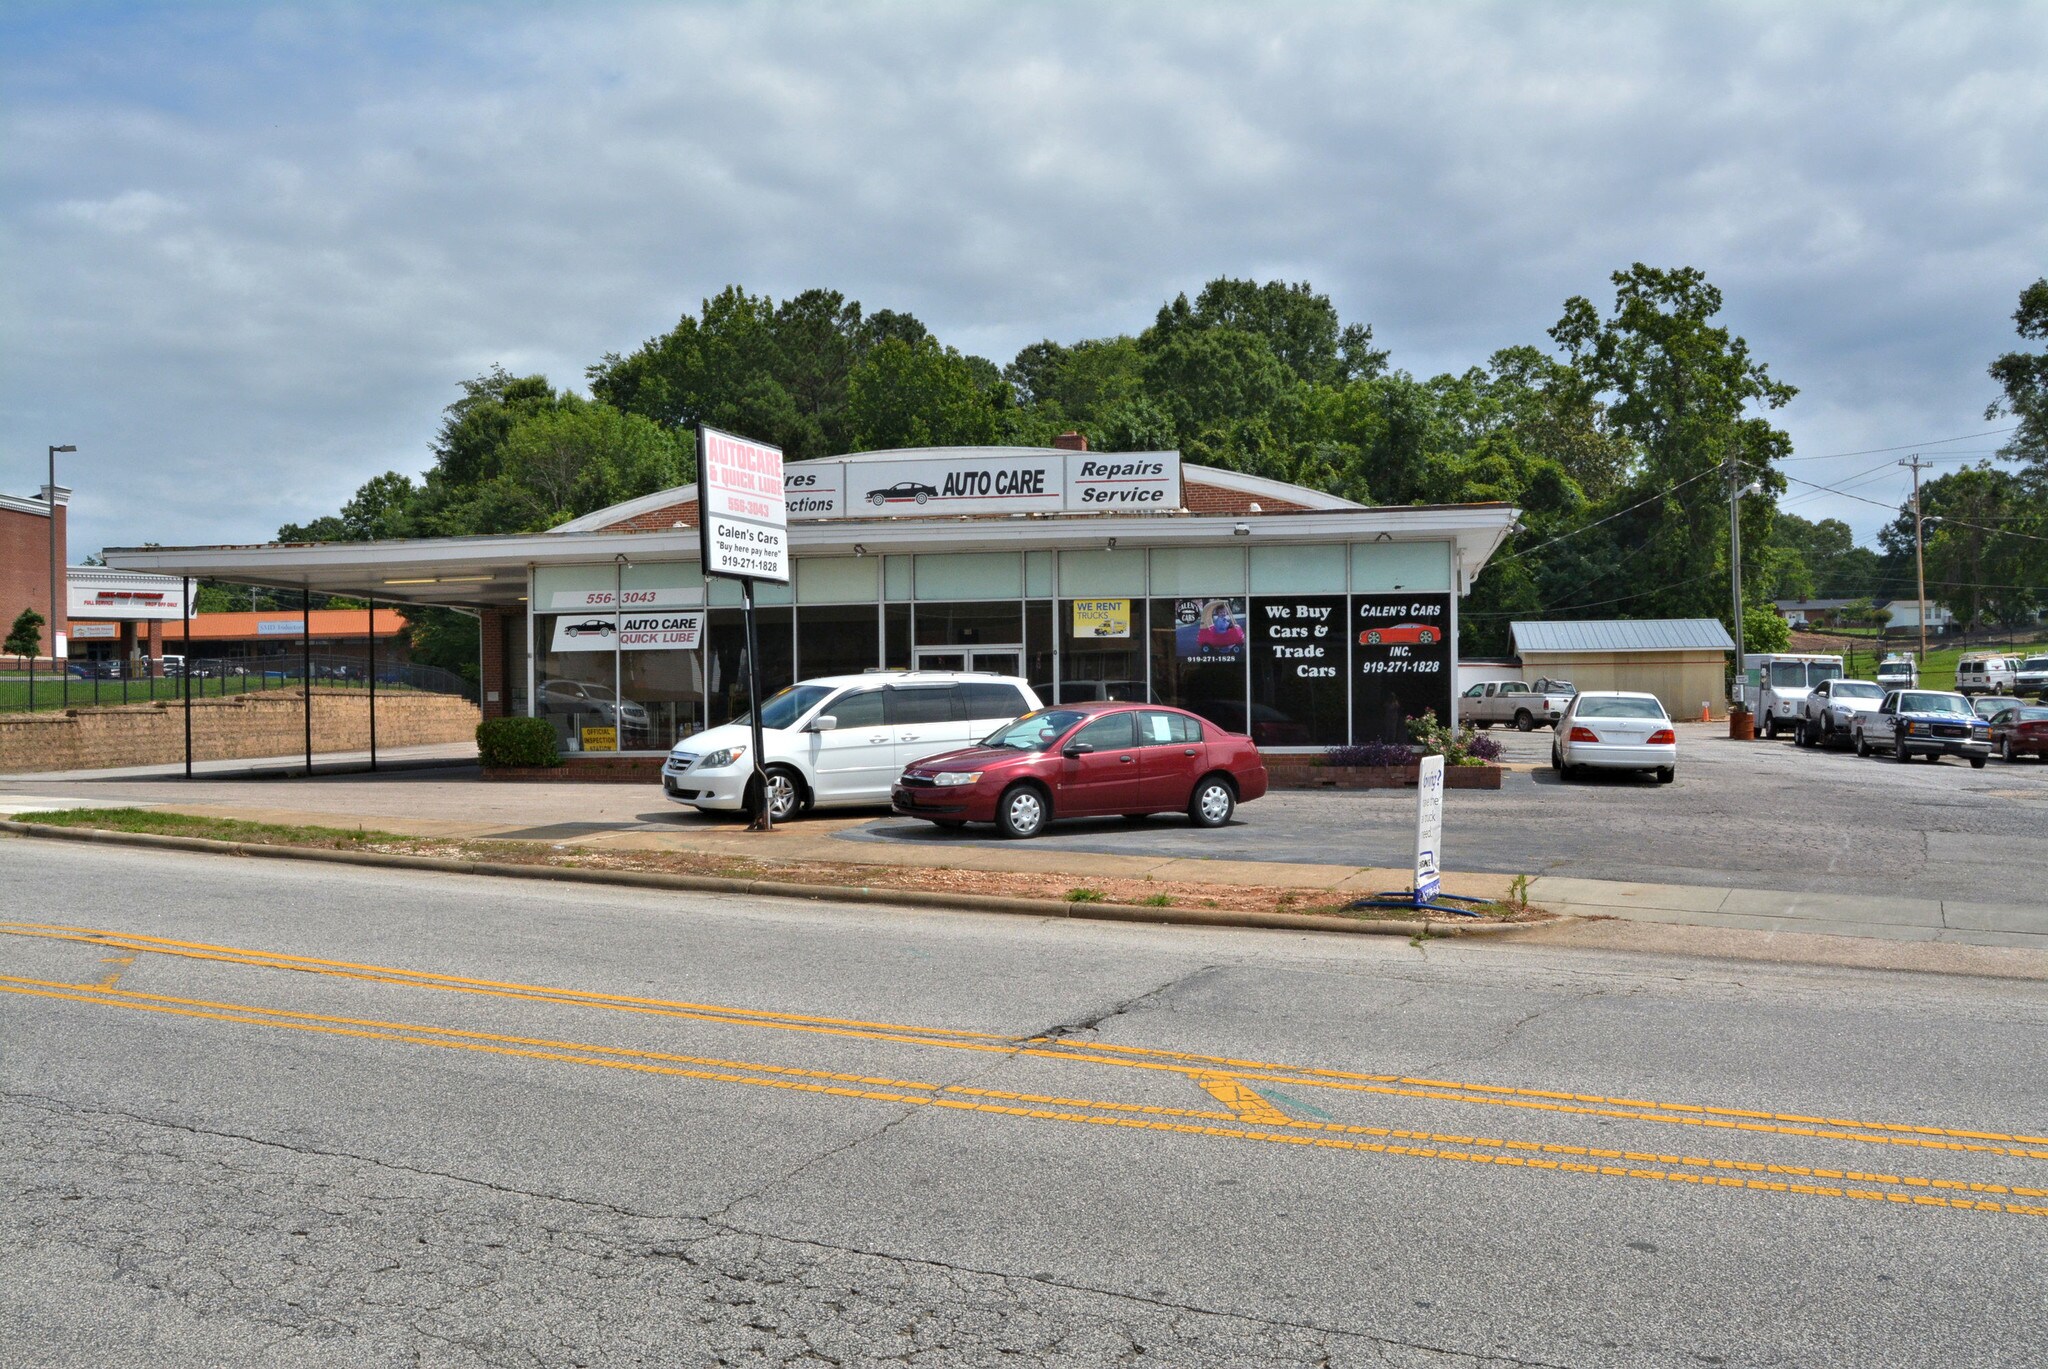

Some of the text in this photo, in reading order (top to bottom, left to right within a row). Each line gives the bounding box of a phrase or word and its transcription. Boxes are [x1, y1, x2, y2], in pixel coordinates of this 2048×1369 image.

[709, 436, 782, 478] AUTOCARE
[1080, 460, 1163, 479] Repairs
[709, 464, 782, 496] & QUICK LUBE
[942, 469, 1045, 496] AUTO CARE
[1082, 487, 1164, 502] Service
[728, 497, 769, 518] 556-3043
[718, 524, 779, 545] Calen's Cars
[734, 543, 749, 554] here
[750, 547, 762, 557] pay
[722, 555, 778, 572] 919-271-1828
[1077, 602, 1122, 611] WE RENT
[1265, 605, 1332, 621] We Buy
[1410, 603, 1441, 616] CARS
[1077, 611, 1109, 620] TRUCKS
[624, 618, 697, 630] AUTO CARE
[620, 633, 695, 644] QUICK LUBE
[1269, 625, 1328, 638] Cars &
[1273, 644, 1324, 658] Trade
[1389, 646, 1412, 657] INC.
[1296, 665, 1336, 678] Cars
[1363, 661, 1440, 673] 919-271-1828
[584, 736, 616, 744] INSPECTION
